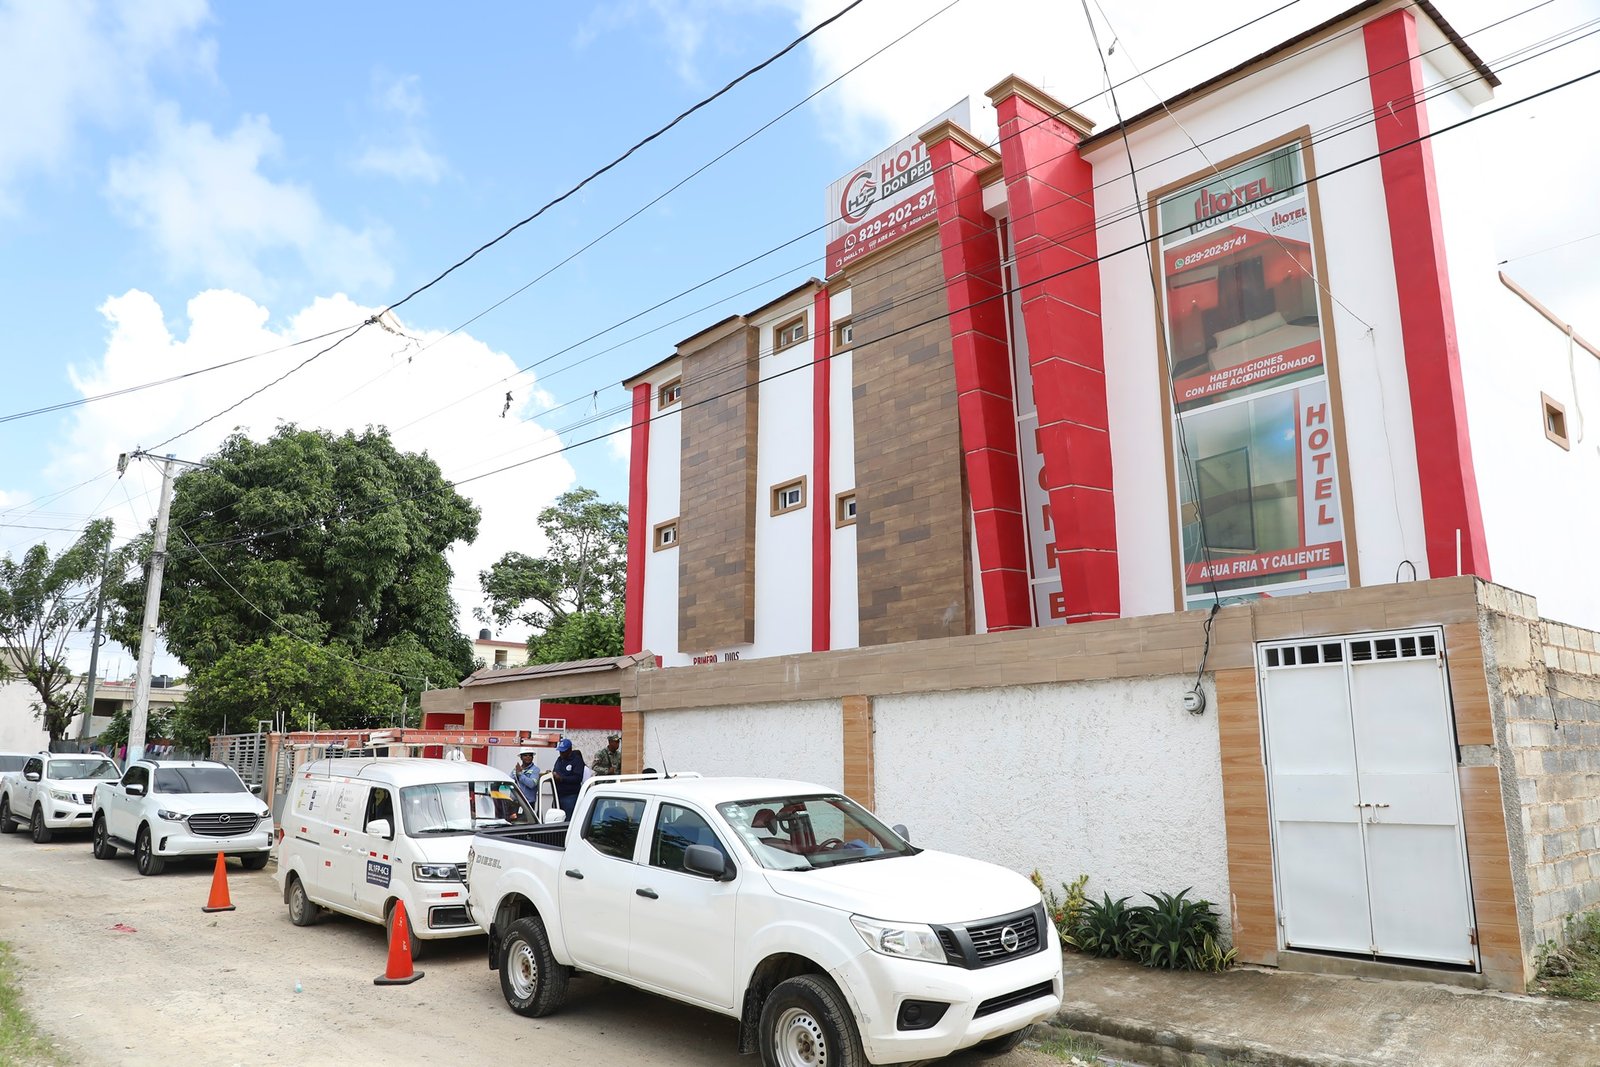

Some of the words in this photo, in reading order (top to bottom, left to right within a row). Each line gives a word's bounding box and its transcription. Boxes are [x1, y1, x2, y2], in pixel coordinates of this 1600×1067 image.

[881, 141, 930, 183] HOT
[883, 173, 908, 197] DON
[910, 160, 932, 181] PED
[1195, 177, 1274, 221] HOTEL
[859, 189, 937, 242] 829-202-87
[1271, 207, 1307, 227] HOTEL
[1184, 234, 1247, 265] 829-202-8741
[1209, 355, 1284, 383] HABITACIONES
[1185, 387, 1204, 398] CON
[1206, 381, 1228, 393] AIRE
[1305, 403, 1334, 526] HOTEL
[1200, 562, 1230, 579] AGUA
[1232, 559, 1258, 574] FRIA
[1260, 558, 1268, 570] Y
[1271, 547, 1331, 568] CALIENTE
[476, 854, 502, 870] DIESEL
